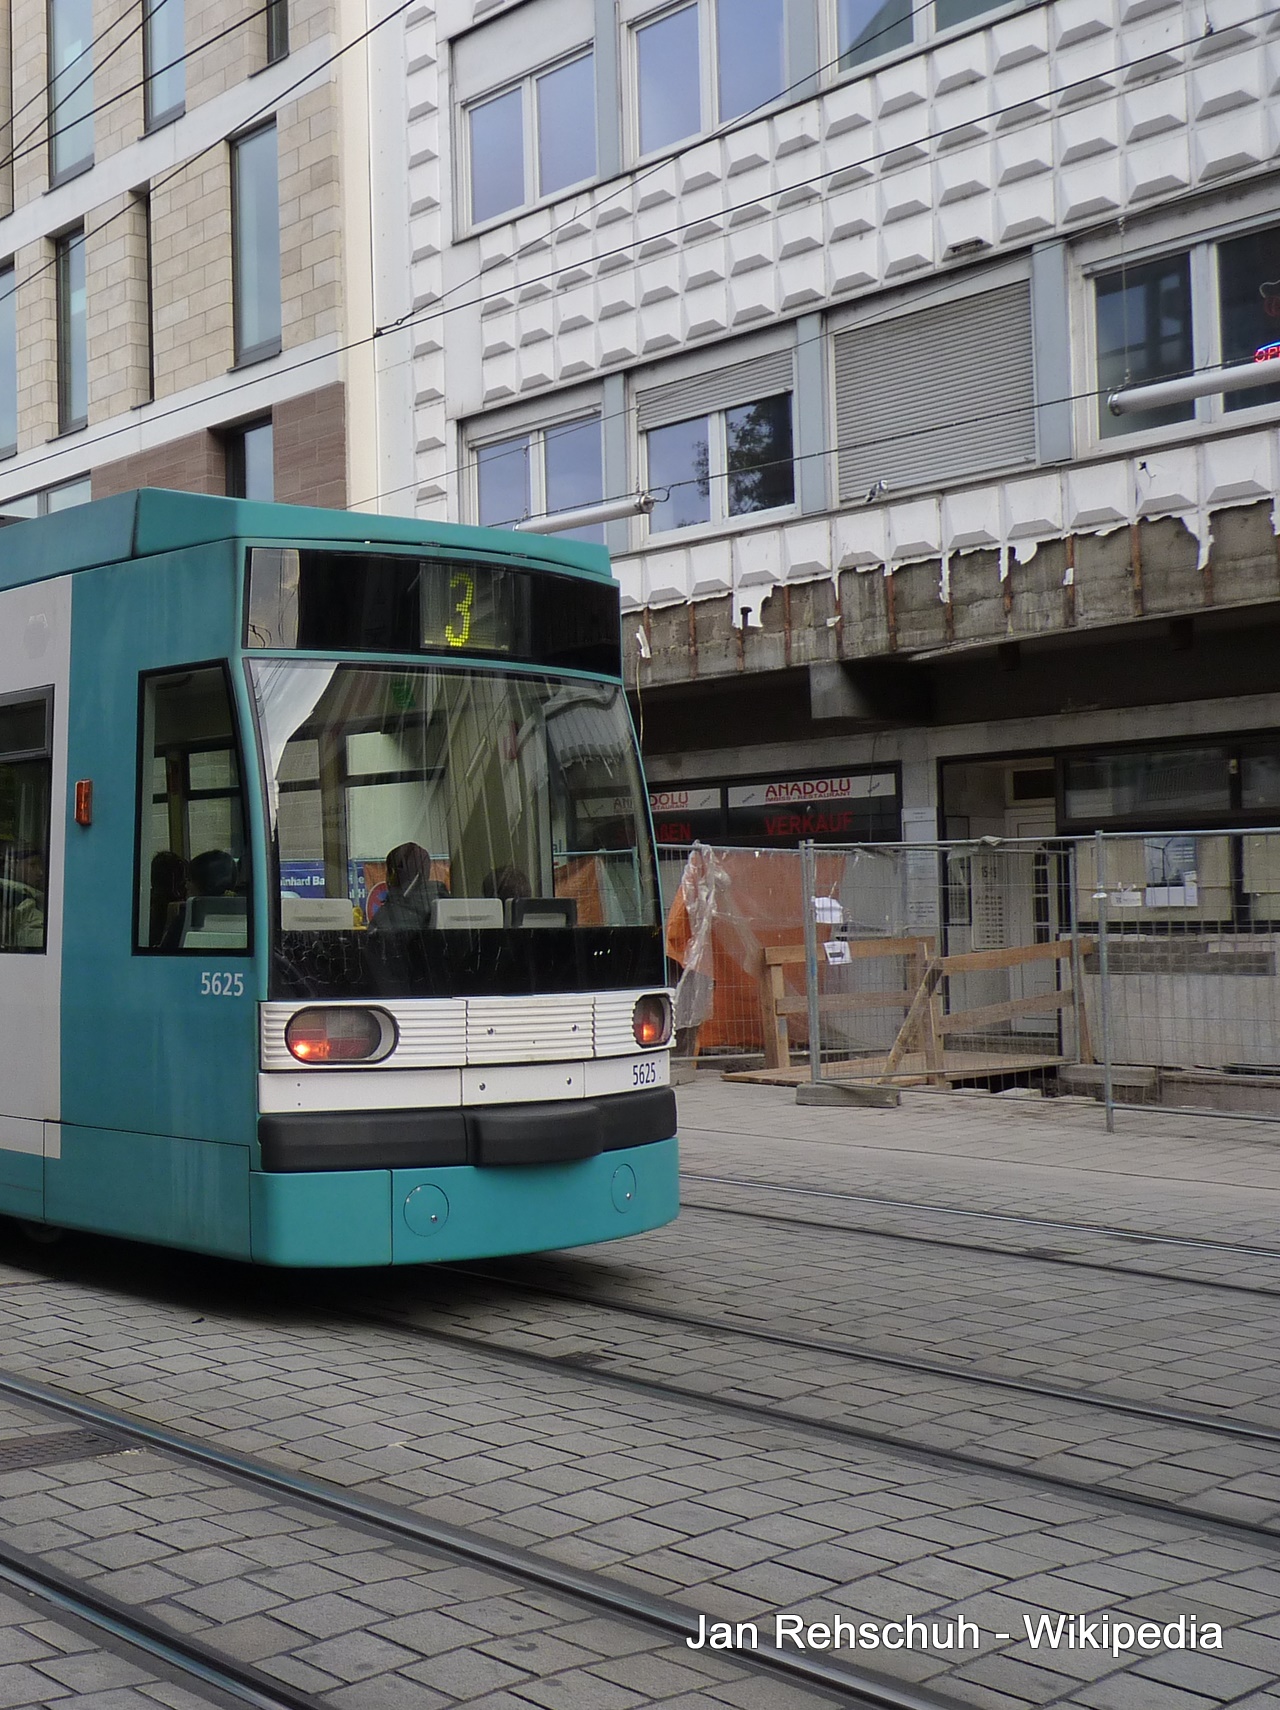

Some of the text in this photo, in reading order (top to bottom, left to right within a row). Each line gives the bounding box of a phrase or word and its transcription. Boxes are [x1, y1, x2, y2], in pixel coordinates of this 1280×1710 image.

[445, 572, 474, 647] 3
[766, 779, 851, 797] ANADOLU
[765, 811, 854, 835] VERKAUF
[201, 972, 244, 997] 5625
[632, 1062, 656, 1086] 5625
